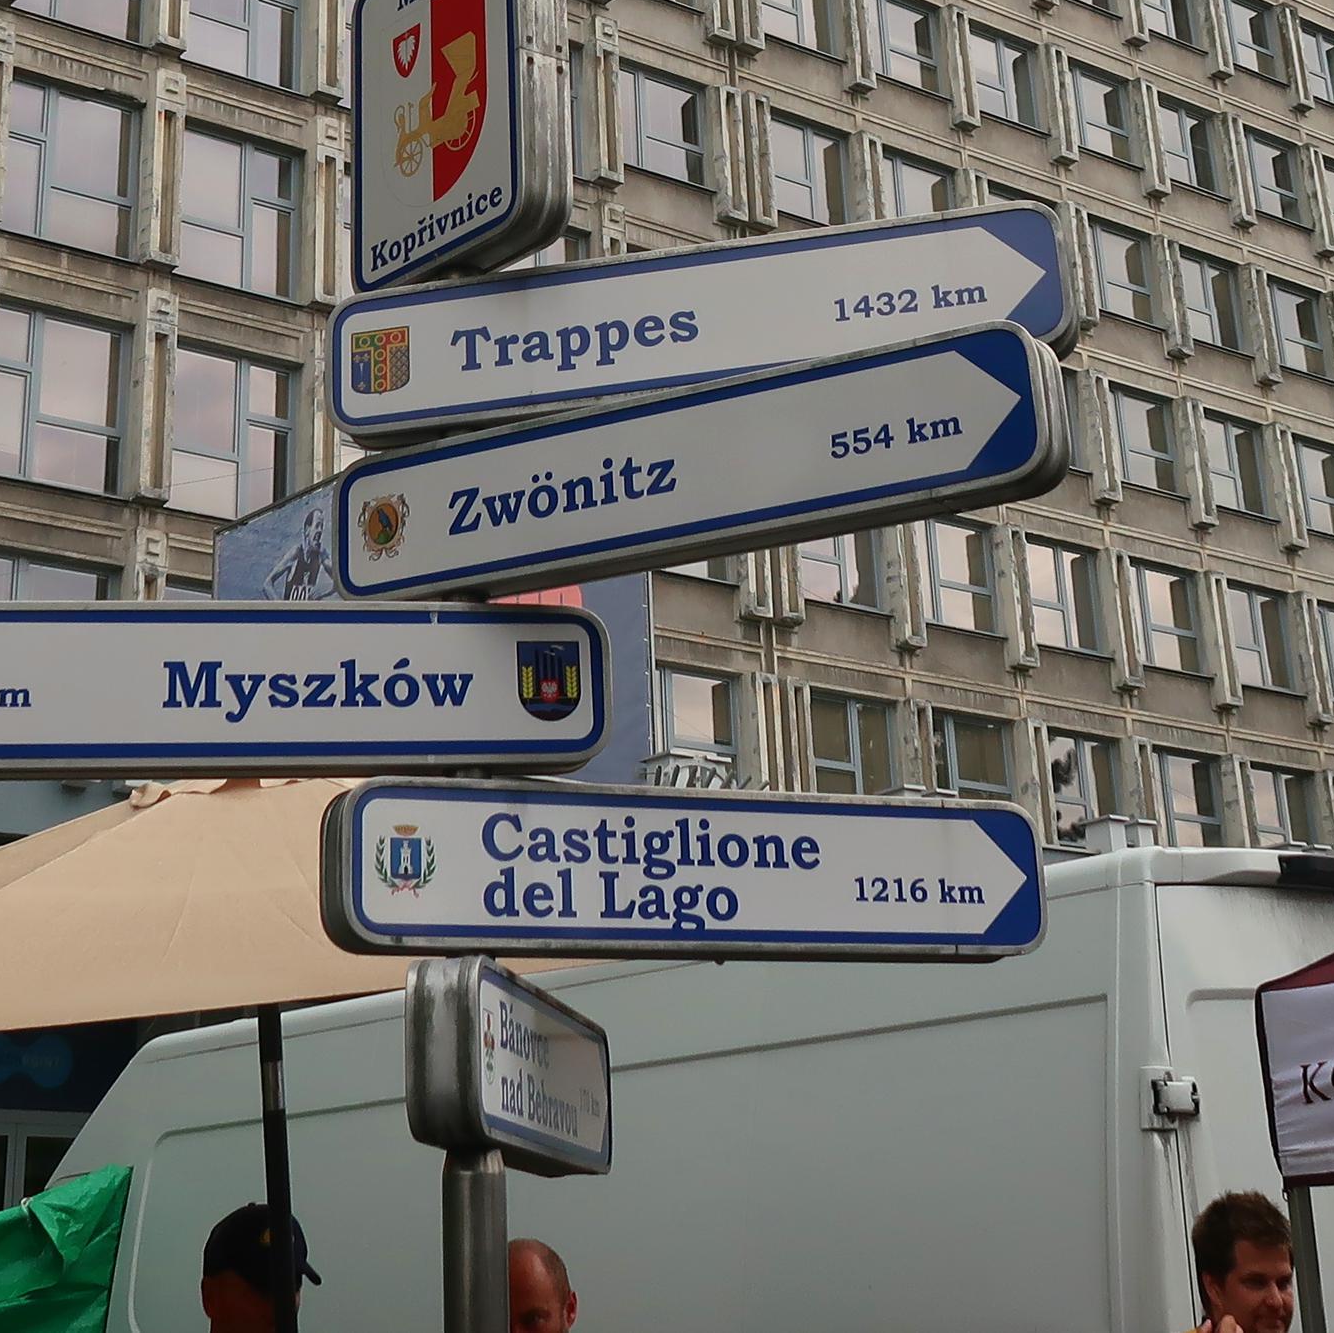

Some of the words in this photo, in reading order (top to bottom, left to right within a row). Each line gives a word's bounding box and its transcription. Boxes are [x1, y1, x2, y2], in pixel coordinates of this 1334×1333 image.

[370, 186, 503, 272] Kopřivnice
[833, 289, 918, 323] 1432
[933, 281, 988, 309] km
[451, 309, 699, 371] Trappes
[830, 423, 894, 459] 554
[907, 412, 963, 444] km
[448, 457, 677, 536] Zwönitz
[162, 658, 474, 723] Myszków
[482, 813, 820, 880] Castiglione
[482, 868, 578, 918] del
[599, 871, 739, 930] Lago
[854, 876, 928, 904] 1216
[939, 877, 985, 905] km
[501, 1068, 523, 1117] nad
